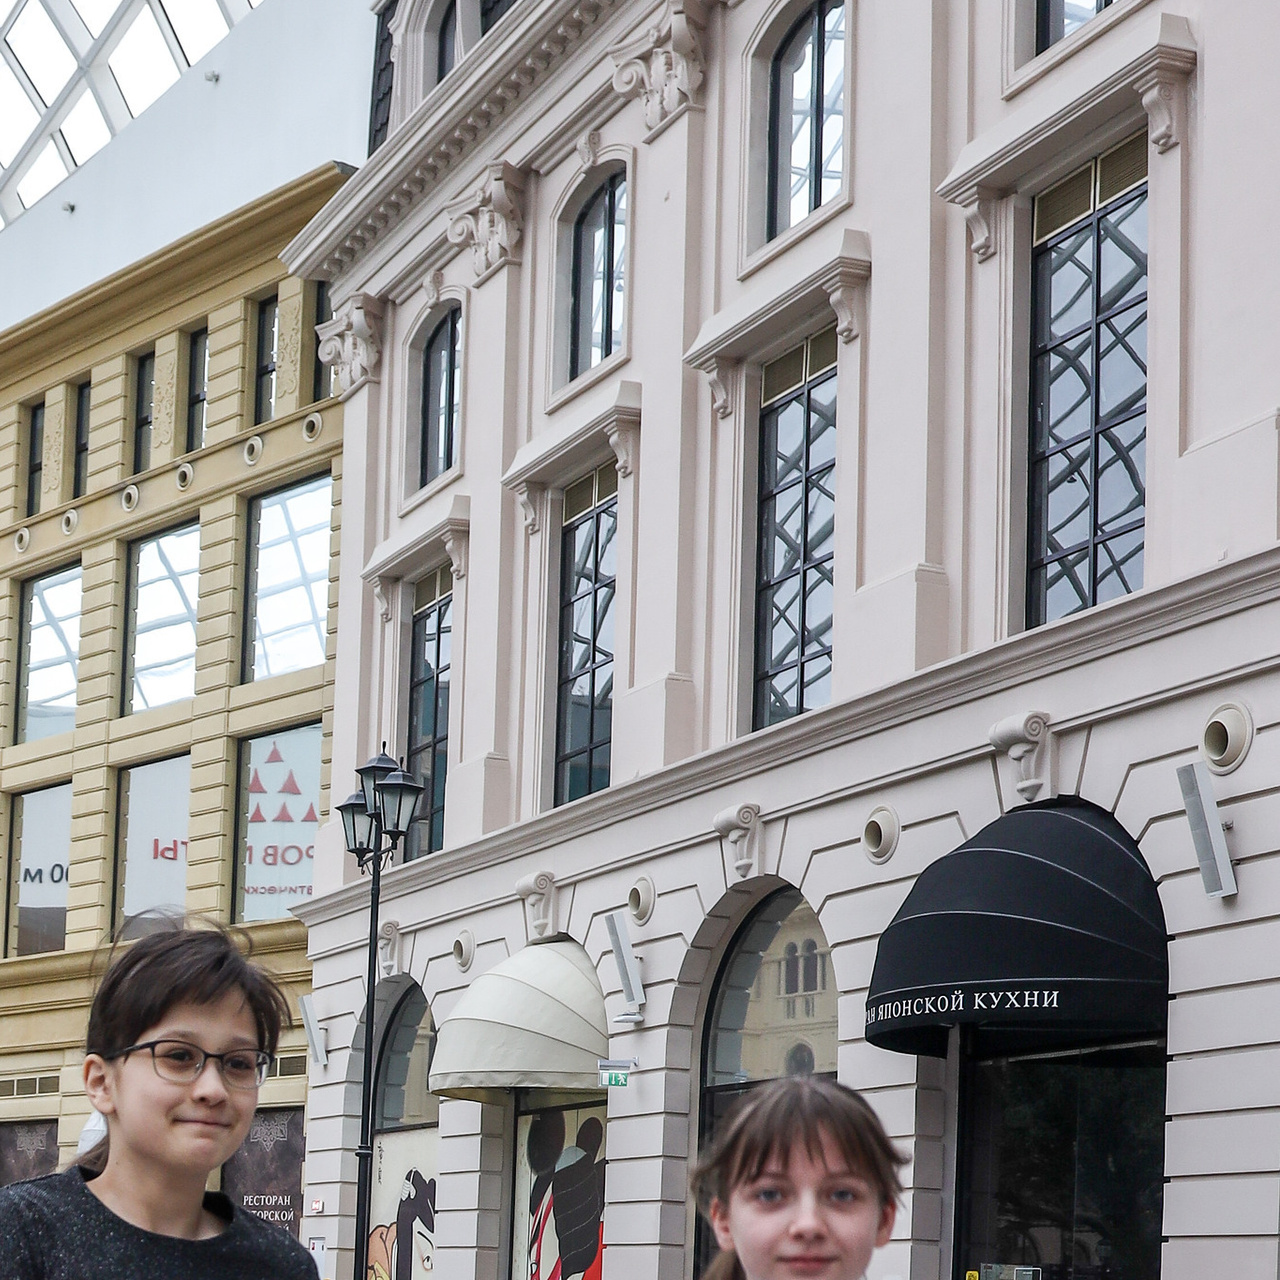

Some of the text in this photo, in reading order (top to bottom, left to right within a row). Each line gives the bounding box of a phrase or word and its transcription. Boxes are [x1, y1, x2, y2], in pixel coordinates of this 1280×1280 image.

[877, 989, 964, 1021] ЯПОНСКОЙ
[973, 990, 1060, 1010] КУХНИ
[243, 1195, 291, 1206] РЕСТОРАН
